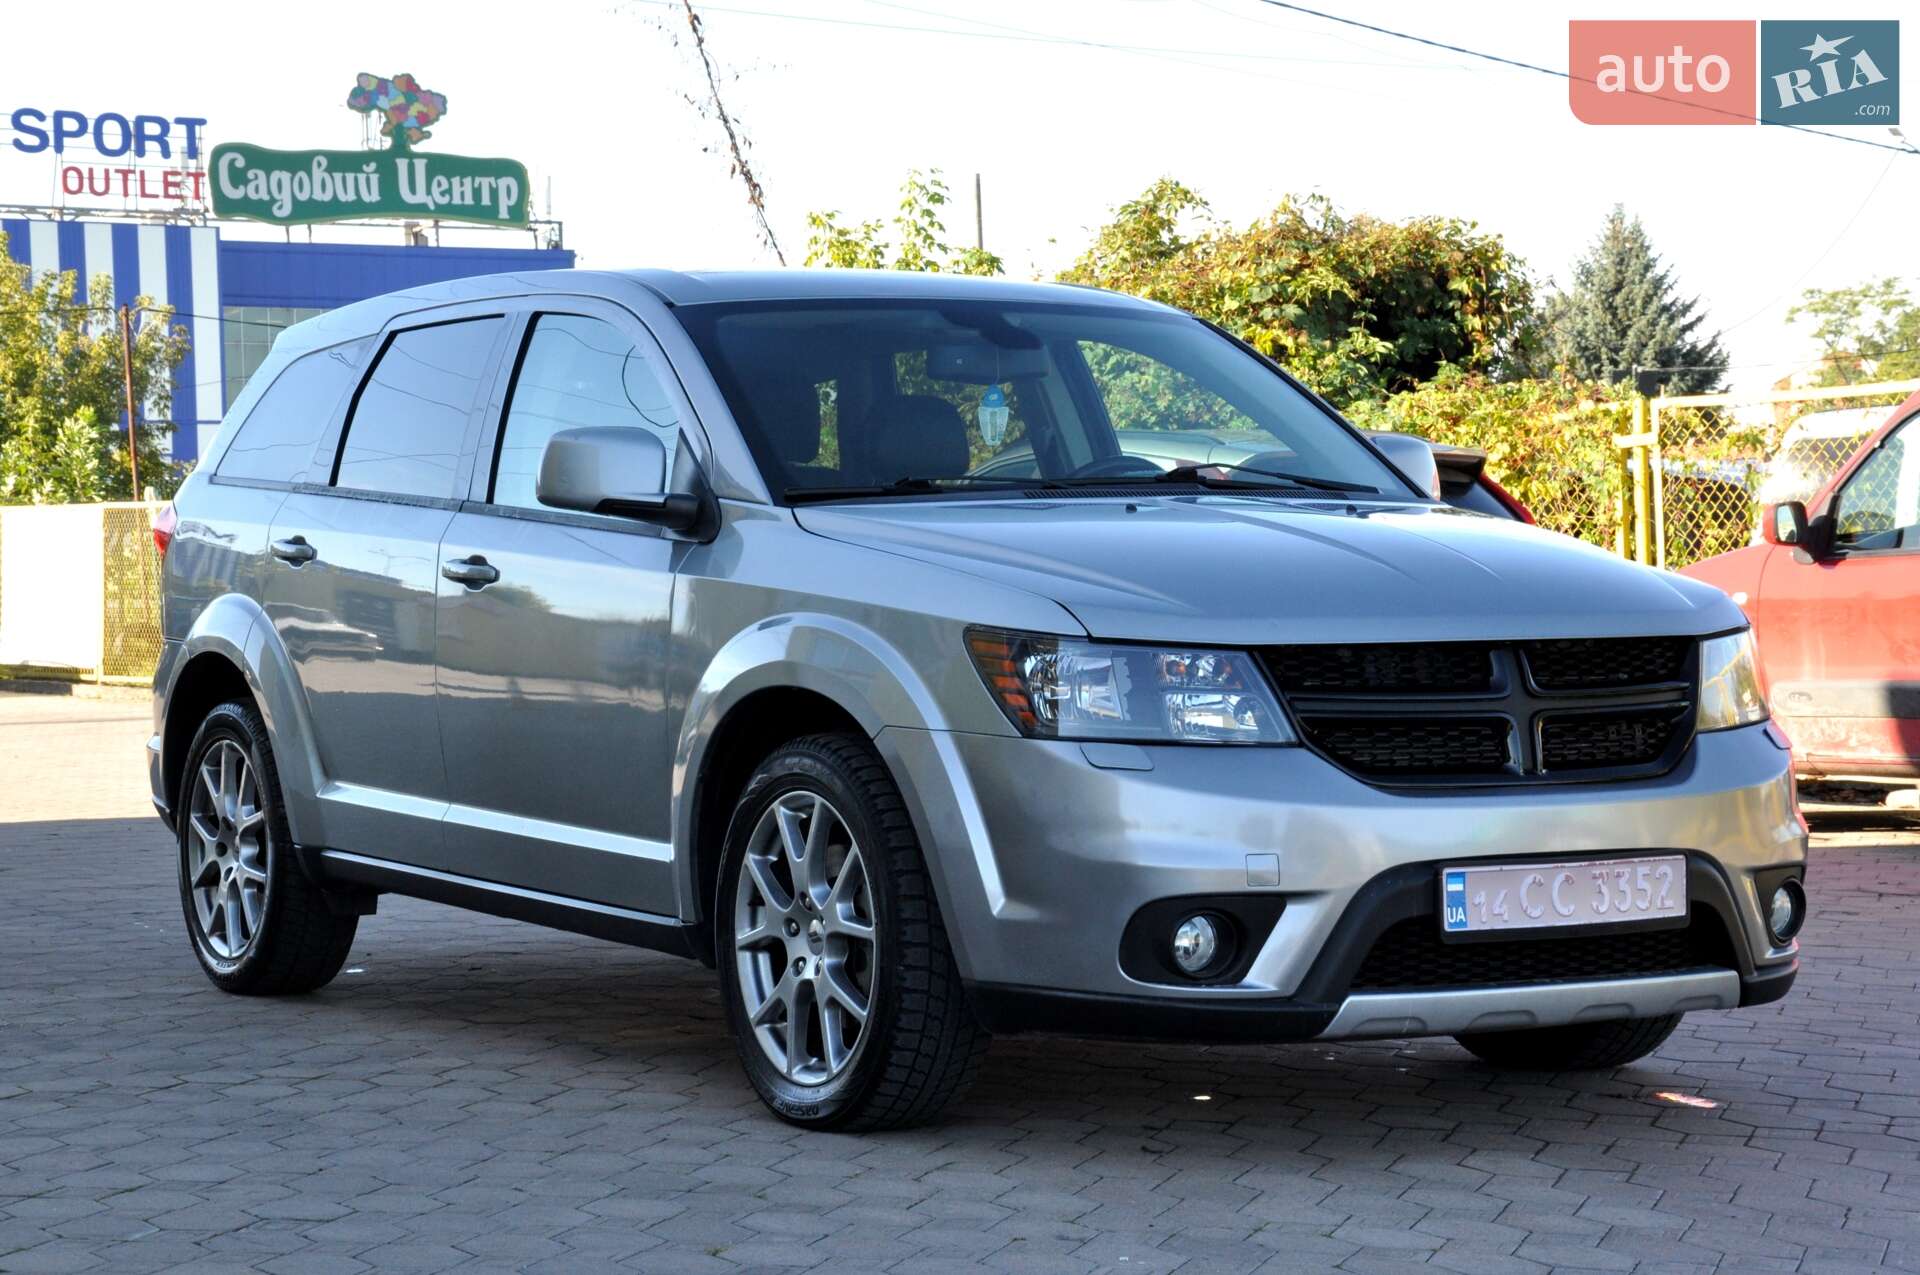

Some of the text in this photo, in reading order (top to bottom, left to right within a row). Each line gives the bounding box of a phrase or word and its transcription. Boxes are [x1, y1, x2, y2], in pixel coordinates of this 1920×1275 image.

[11, 107, 207, 159] SPORT
[62, 166, 206, 200] OUTLET
[218, 152, 519, 219] Садовий Центр
[1447, 907, 1466, 923] UA
[1520, 872, 1576, 919] CC
[1592, 864, 1675, 914] 3352
